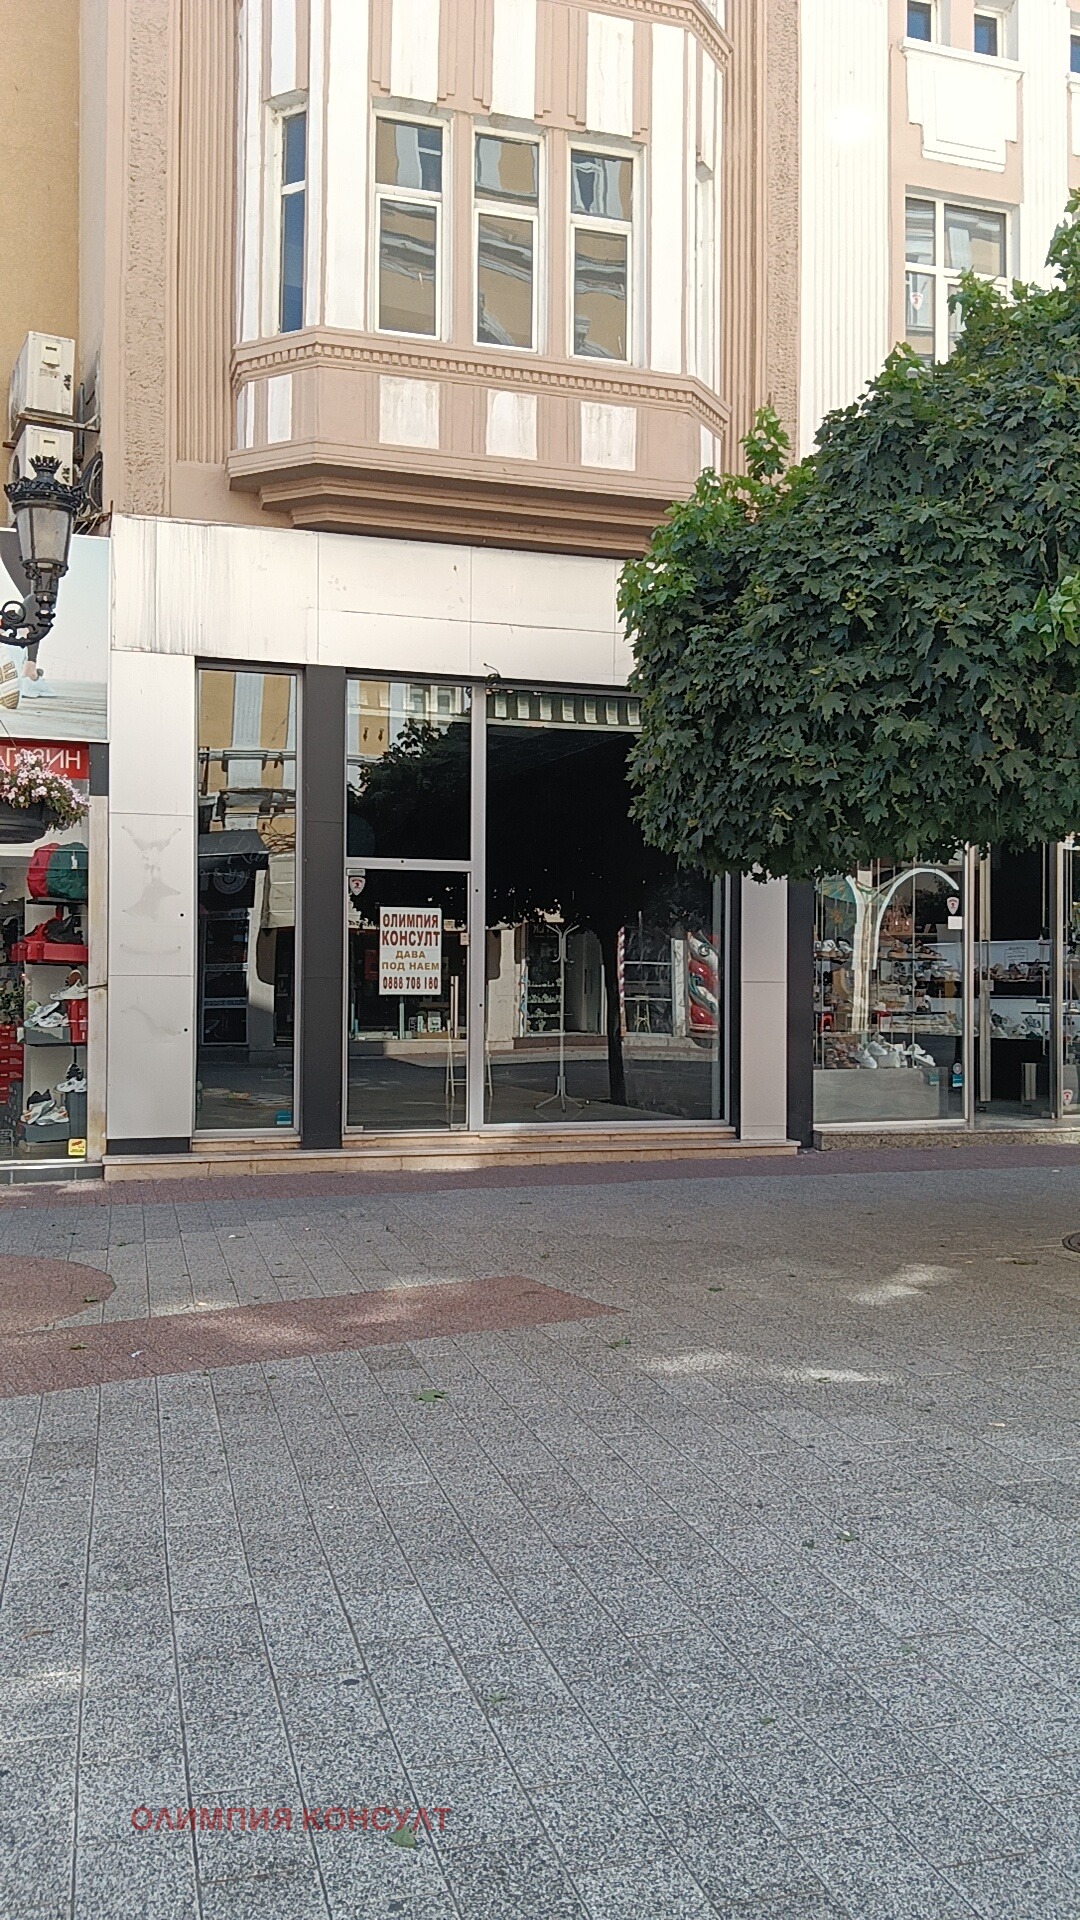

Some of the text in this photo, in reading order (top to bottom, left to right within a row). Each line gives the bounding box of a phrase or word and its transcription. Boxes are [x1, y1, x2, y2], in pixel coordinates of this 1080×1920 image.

[383, 914, 438, 928] ОЛИМПИЯ
[382, 931, 440, 946] КОНСУЛТ
[396, 951, 425, 959] ДАВА
[382, 962, 439, 971] ПОД НАЕМ
